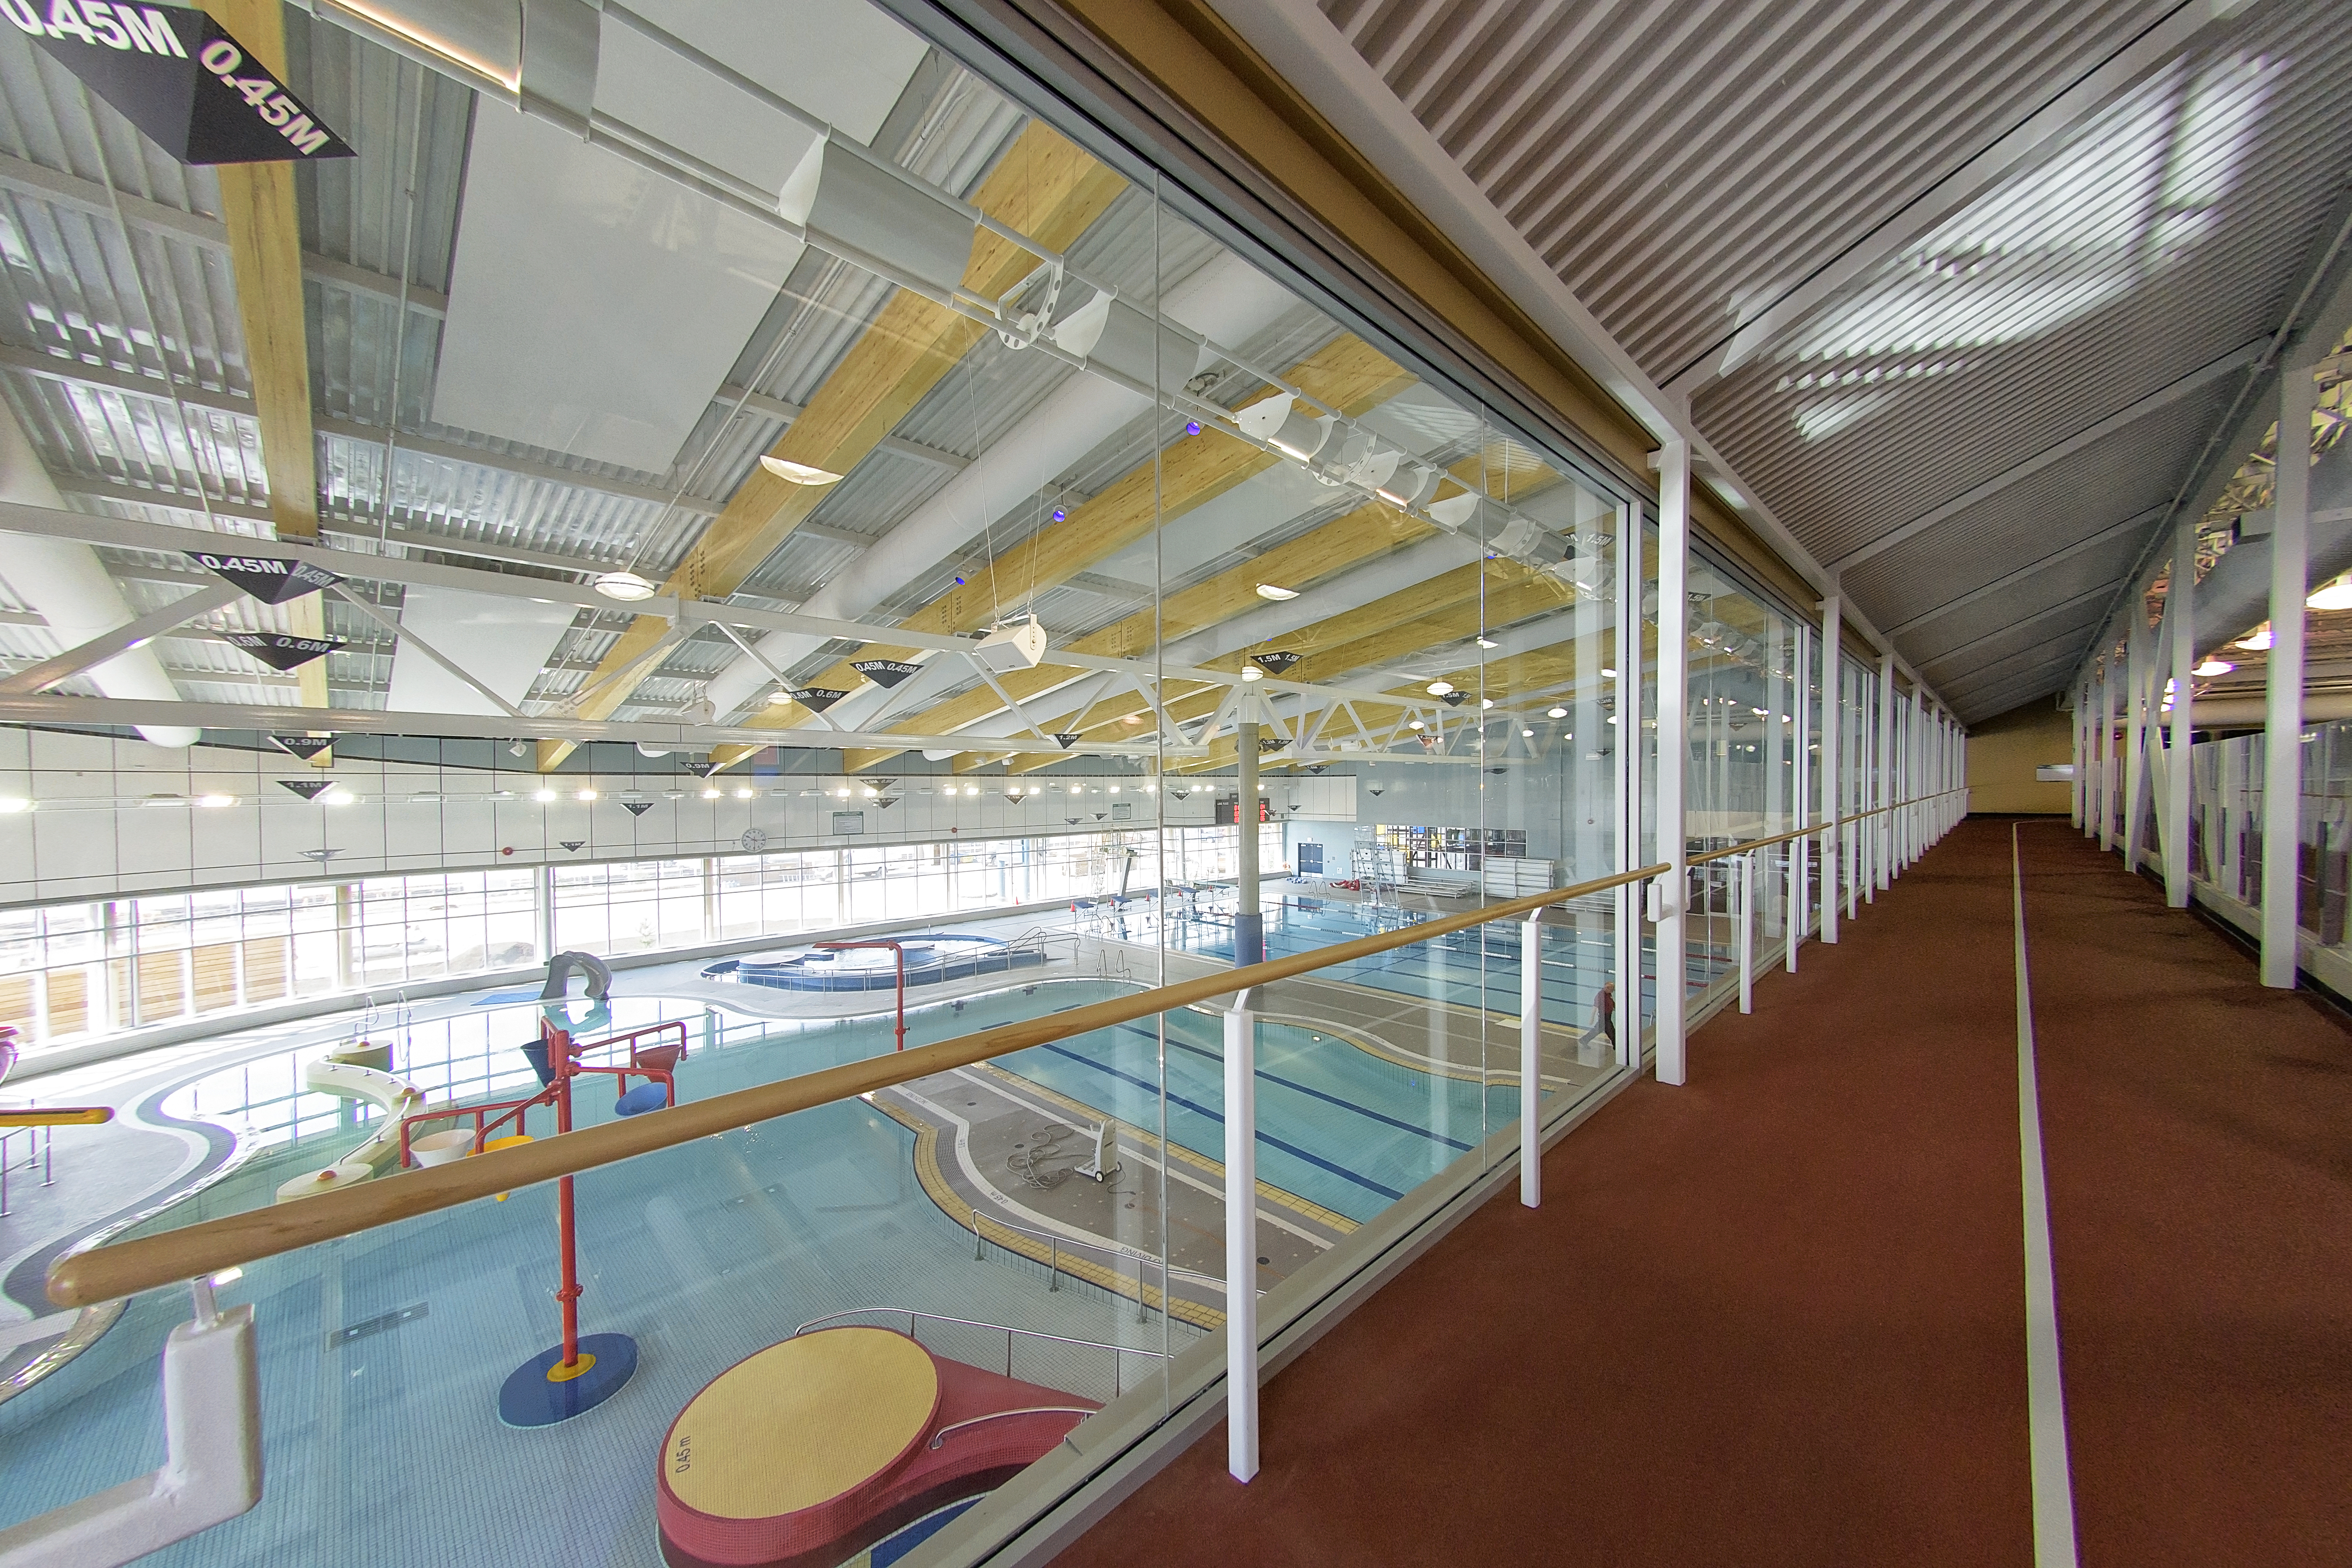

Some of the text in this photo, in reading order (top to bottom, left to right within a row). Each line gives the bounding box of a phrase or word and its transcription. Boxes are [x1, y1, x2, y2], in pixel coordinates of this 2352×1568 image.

[198, 38, 330, 155] 0.45M
[1587, 534, 1613, 546] 1.5M
[200, 555, 288, 574] 0.45M
[294, 565, 336, 588] 0.45M
[226, 636, 268, 647] 0.6M
[276, 637, 330, 652] 0.6M
[1258, 654, 1281, 663] 1.5M
[856, 662, 885, 672] 0.45M
[886, 663, 918, 674] 0.45M
[790, 690, 812, 699] 0.6M
[816, 689, 842, 699] 0.6M
[994, 1195, 1008, 1204] 0.45
[1120, 1247, 1152, 1260] DIVING
[676, 1435, 691, 1473] 0.45 m
